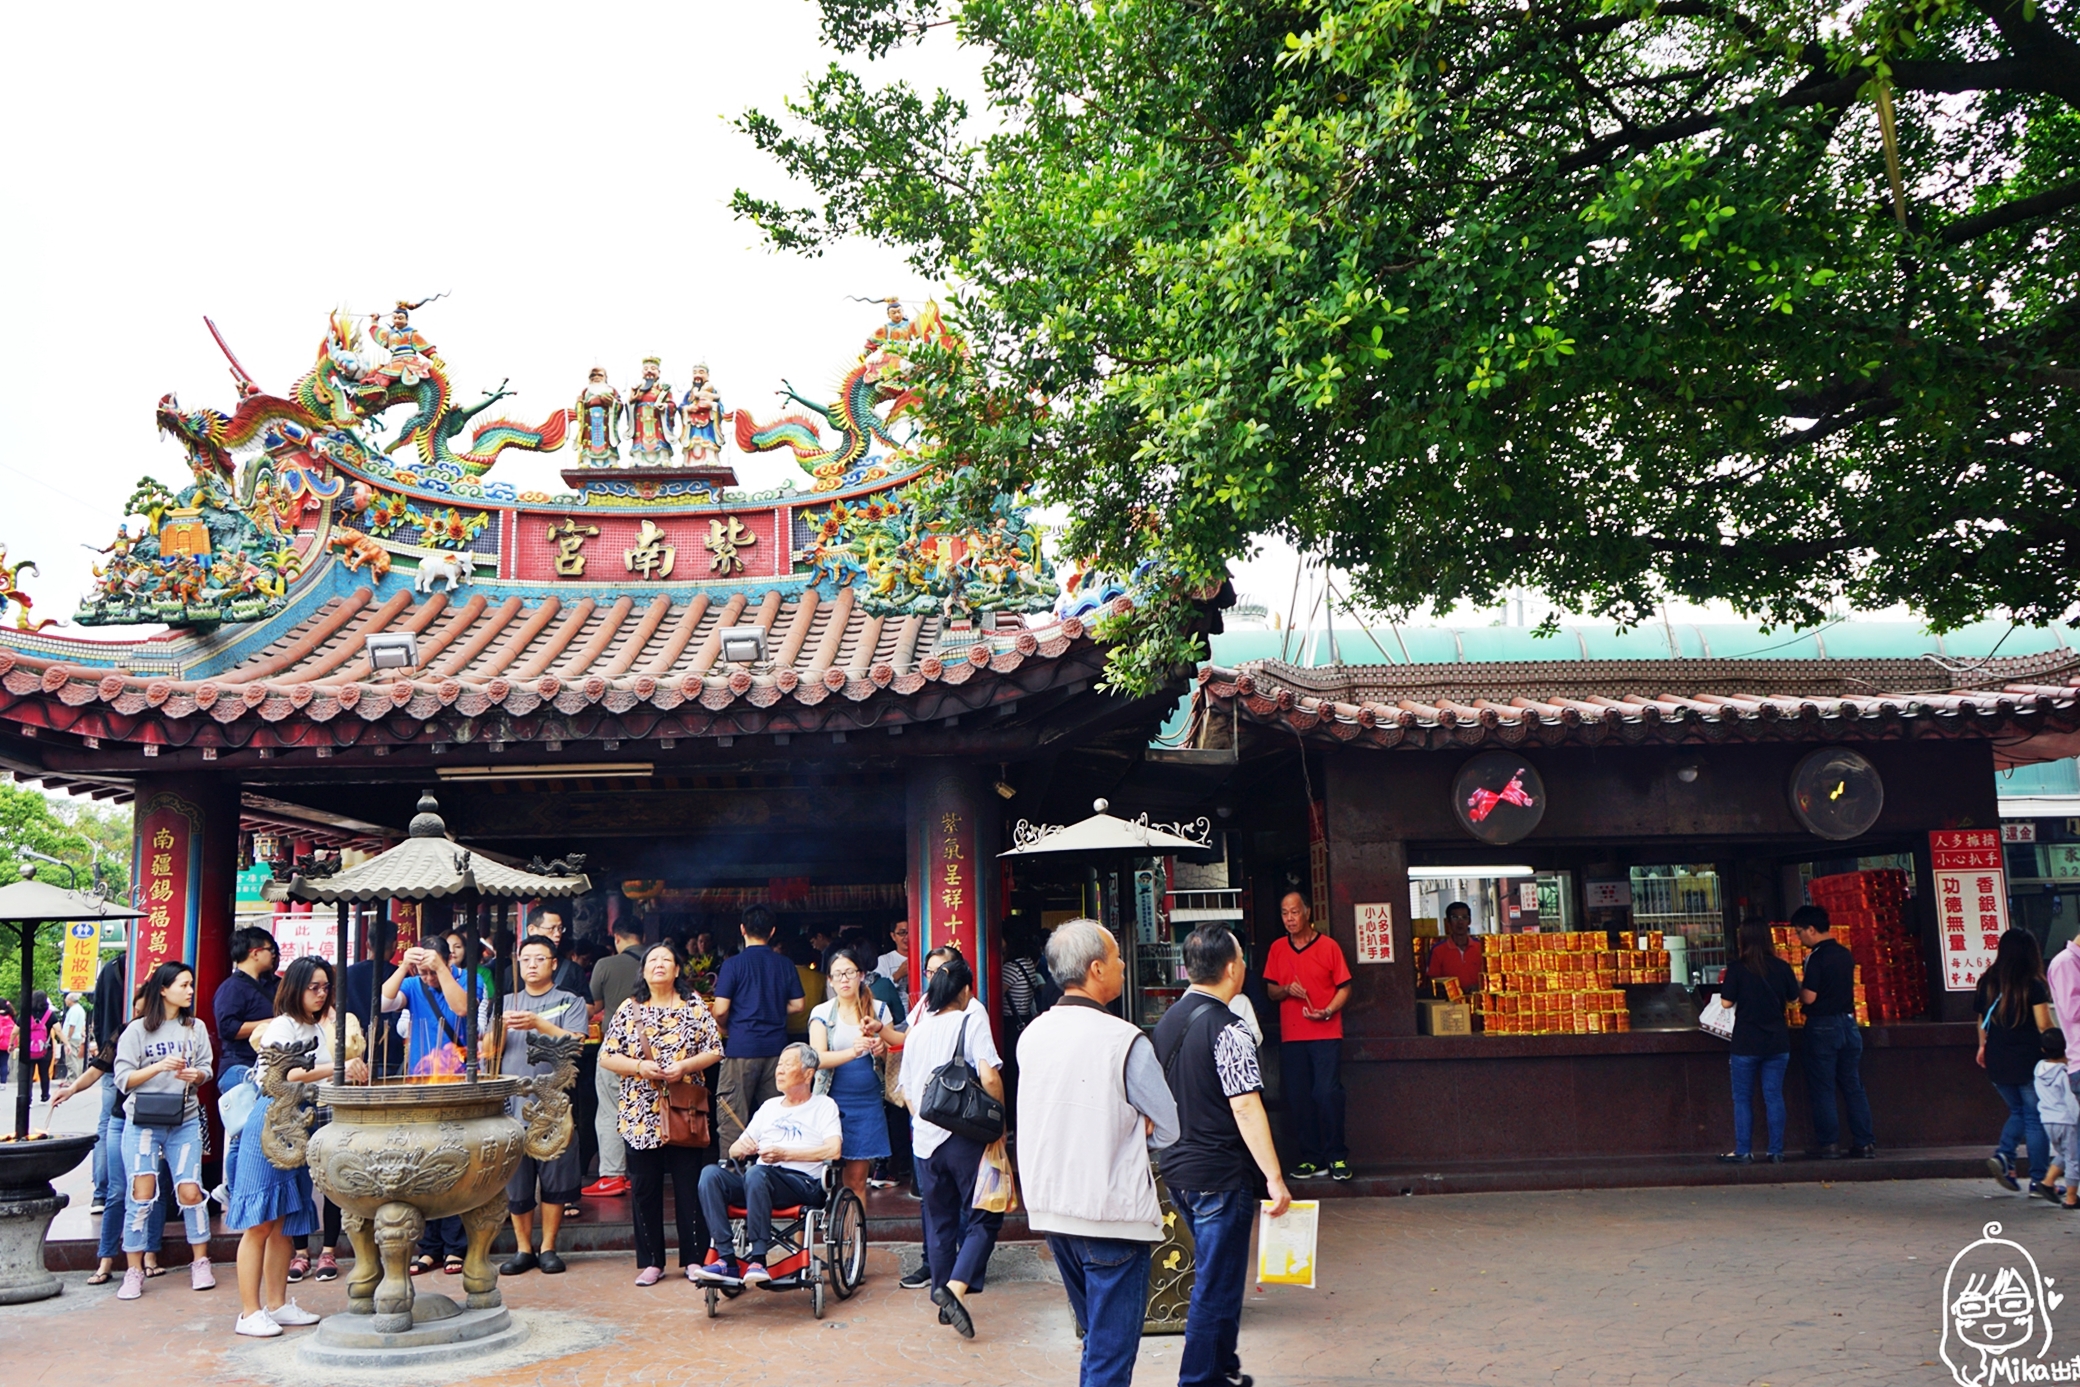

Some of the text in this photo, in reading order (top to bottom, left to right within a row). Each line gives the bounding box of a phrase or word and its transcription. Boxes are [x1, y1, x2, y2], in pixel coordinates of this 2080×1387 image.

[546, 516, 757, 580] 紫南宮
[1934, 832, 1997, 849] 人多擁擠
[1937, 851, 1998, 867] 小心扒手
[1365, 907, 1378, 959] 小心扒手
[1378, 906, 1391, 959] 人多擁擠
[1942, 877, 1967, 951] 功德無量
[1976, 876, 2000, 950] 香銀隨意
[70, 940, 91, 991] 化妝室
[1951, 972, 1986, 985] 紫南
